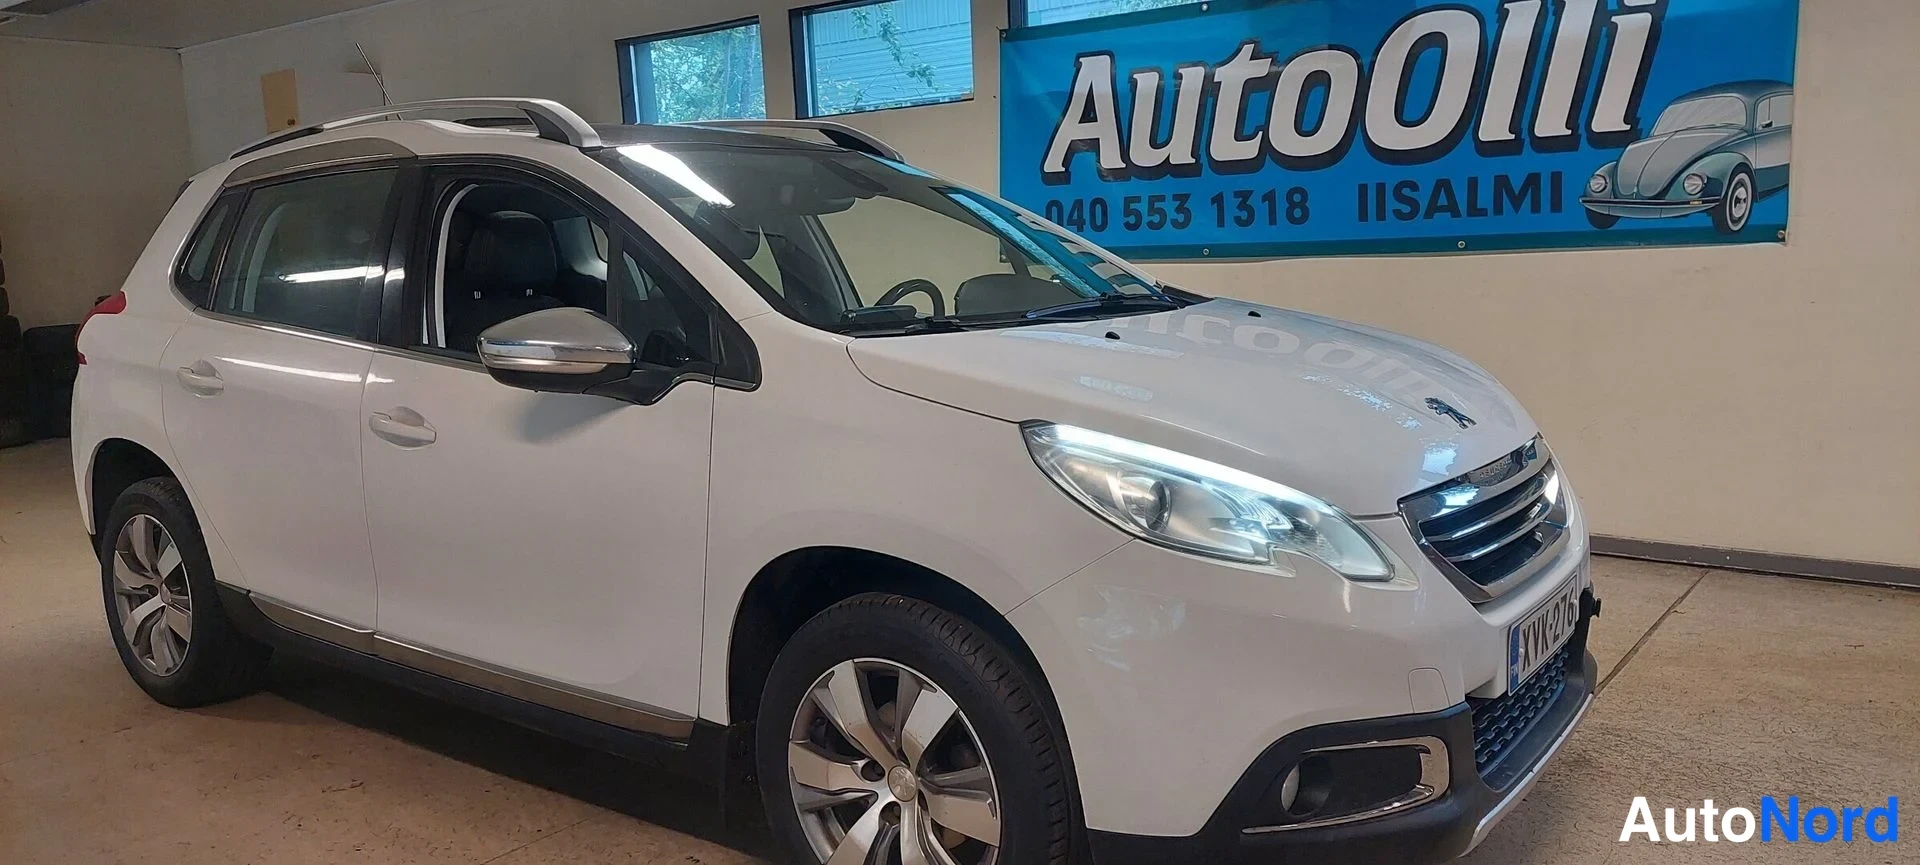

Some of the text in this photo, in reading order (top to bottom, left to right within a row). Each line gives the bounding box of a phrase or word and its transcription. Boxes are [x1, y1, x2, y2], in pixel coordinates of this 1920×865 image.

[1041, 0, 1662, 180] AutoOlli
[1045, 186, 1310, 233] 040 553 1318
[1358, 171, 1563, 222] IISALMI
[1522, 587, 1574, 672] XVK-276
